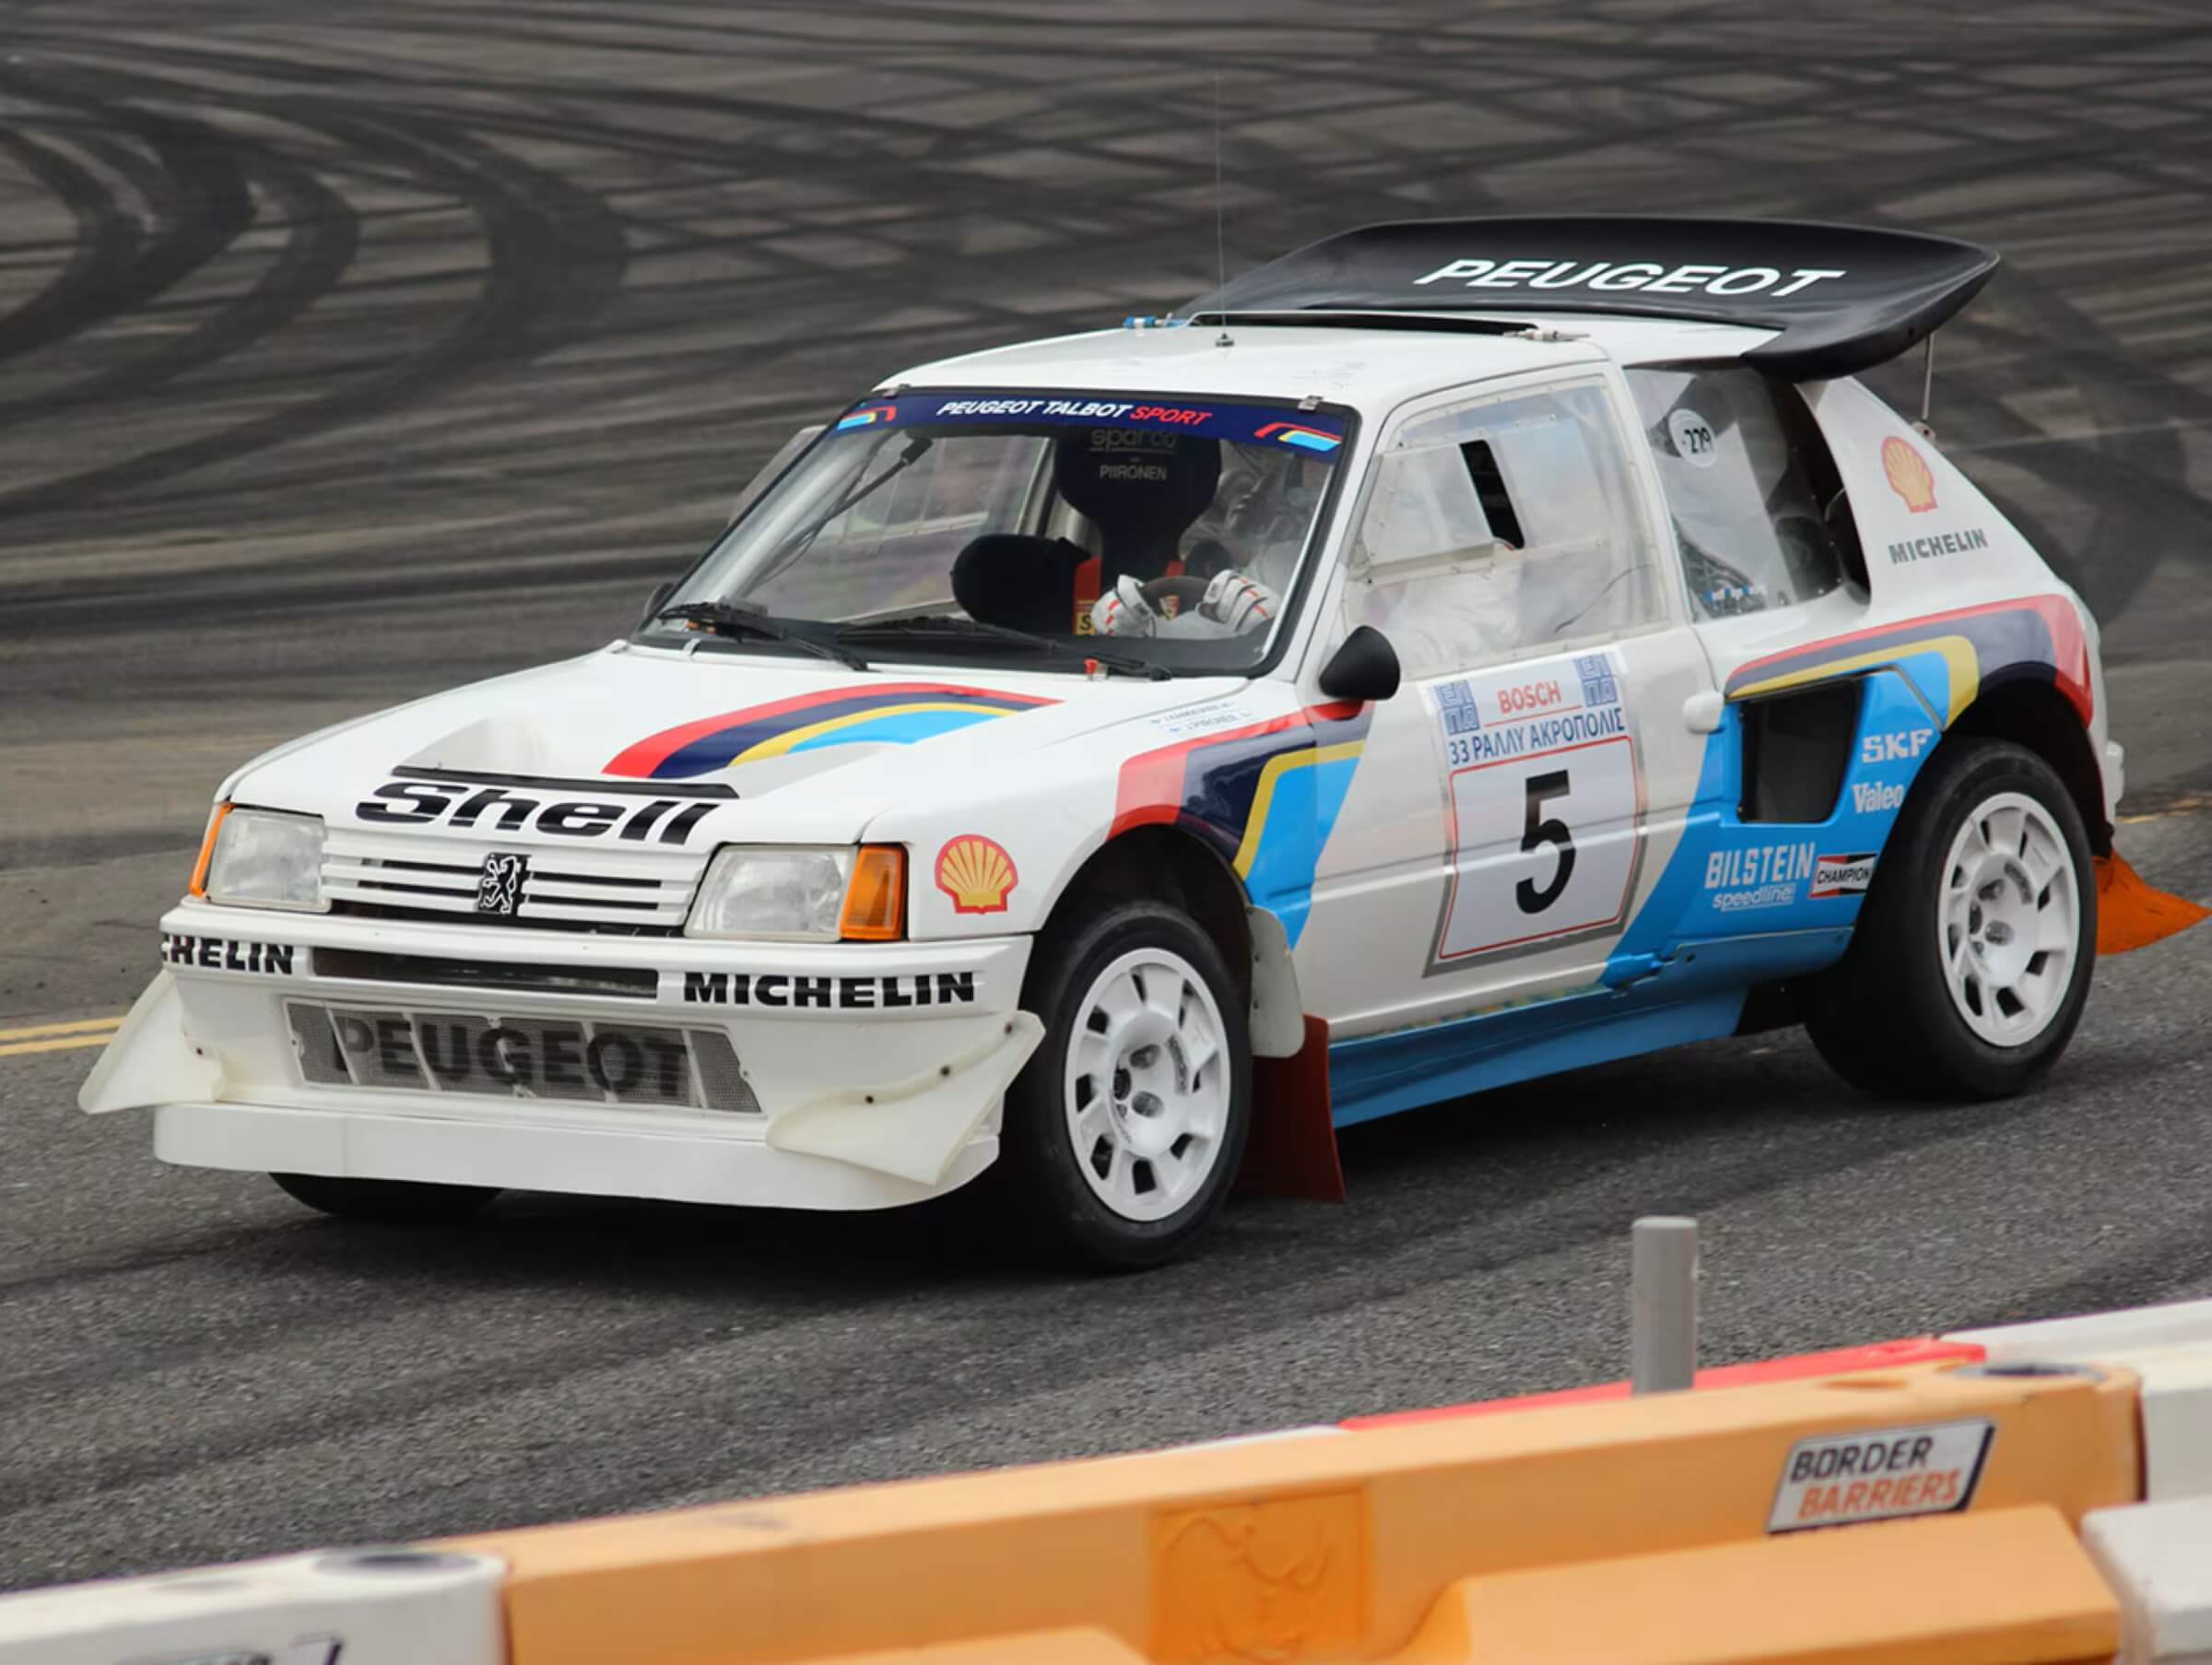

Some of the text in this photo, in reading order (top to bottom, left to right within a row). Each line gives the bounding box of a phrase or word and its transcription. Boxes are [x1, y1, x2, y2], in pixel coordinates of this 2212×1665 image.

[1414, 258, 1845, 297] PEUGEOT
[936, 400, 1213, 426] PEUGEOT TALBOT SPORT
[1100, 464, 1168, 480] PIIRONEN
[1888, 529, 1987, 564] MICHELIN
[1498, 680, 1561, 714] BOSCH
[1449, 741, 1470, 765] 33
[1862, 728, 1933, 763] SKF
[355, 781, 721, 845] Shell
[1852, 781, 1904, 814] Valeo
[1515, 769, 1577, 915] 5
[1704, 842, 1816, 890] BILSTEIN
[1817, 868, 1873, 885] CHAMPION
[1712, 882, 1794, 911] speedline
[160, 932, 294, 975] HELIN
[684, 971, 974, 1008] MICHELIN
[335, 1015, 690, 1097] PEUGEOT
[1791, 1435, 1934, 1483] BORDER
[1798, 1469, 1961, 1519] BARRIERS
